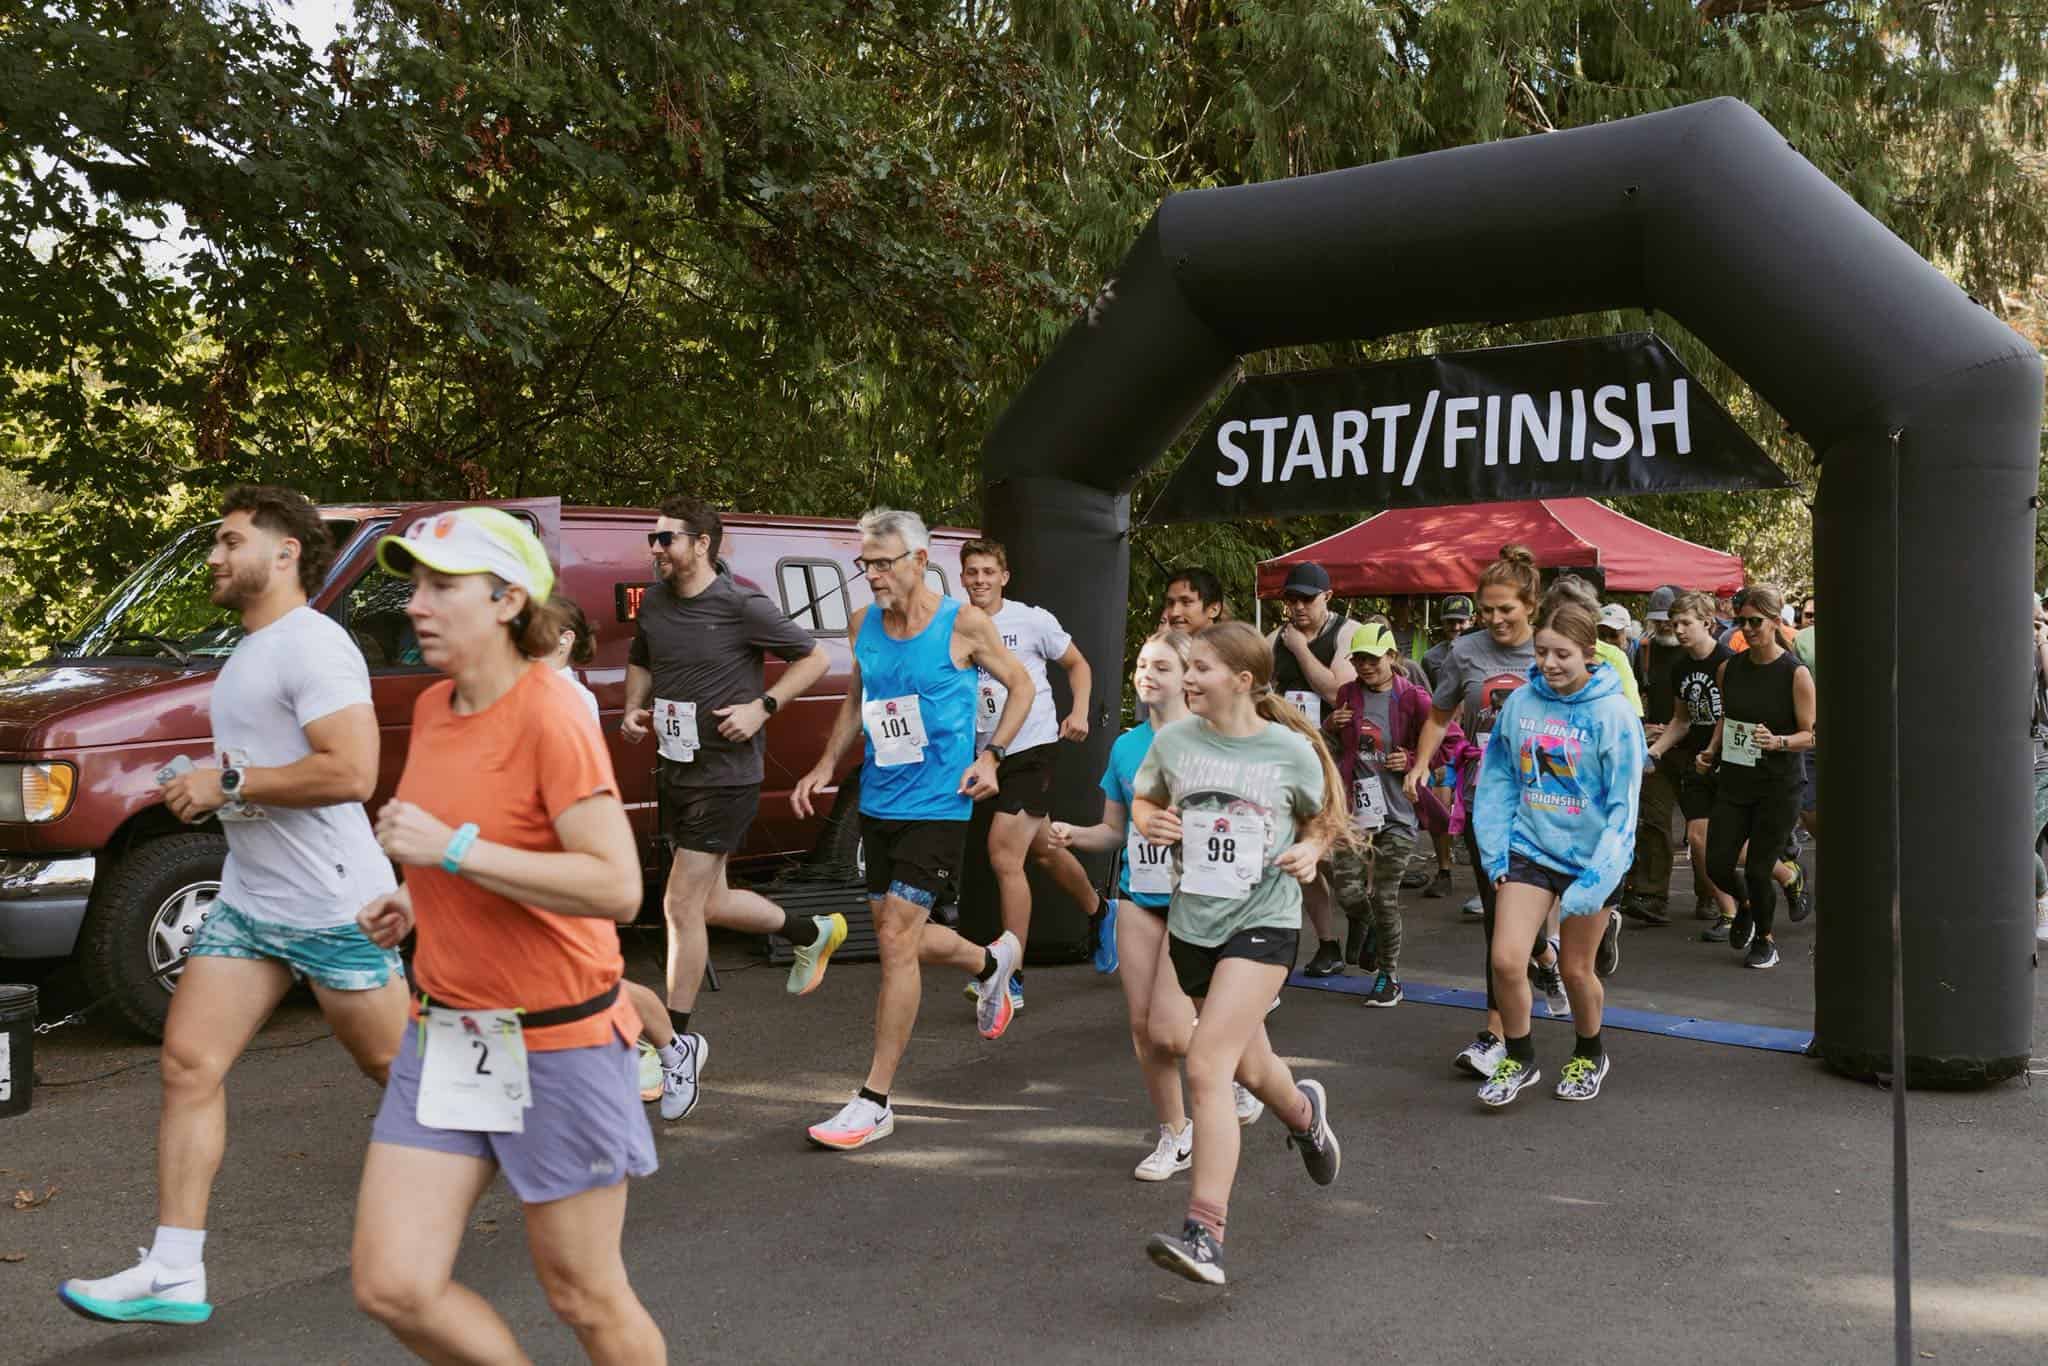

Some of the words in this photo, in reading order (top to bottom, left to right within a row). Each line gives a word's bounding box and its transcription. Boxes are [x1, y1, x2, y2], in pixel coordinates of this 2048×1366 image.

[1216, 378, 1691, 487] START/FINISH
[986, 698, 996, 714] 9
[665, 719, 681, 737] 15
[881, 717, 911, 738] 101
[1519, 718, 1592, 743] NAIONAL
[1734, 732, 1748, 747] 57
[1355, 792, 1371, 809] 63
[1527, 792, 1589, 809] PIONSHIP
[1138, 842, 1169, 865] 107
[1208, 837, 1236, 864] 98
[472, 1040, 492, 1075] 2
